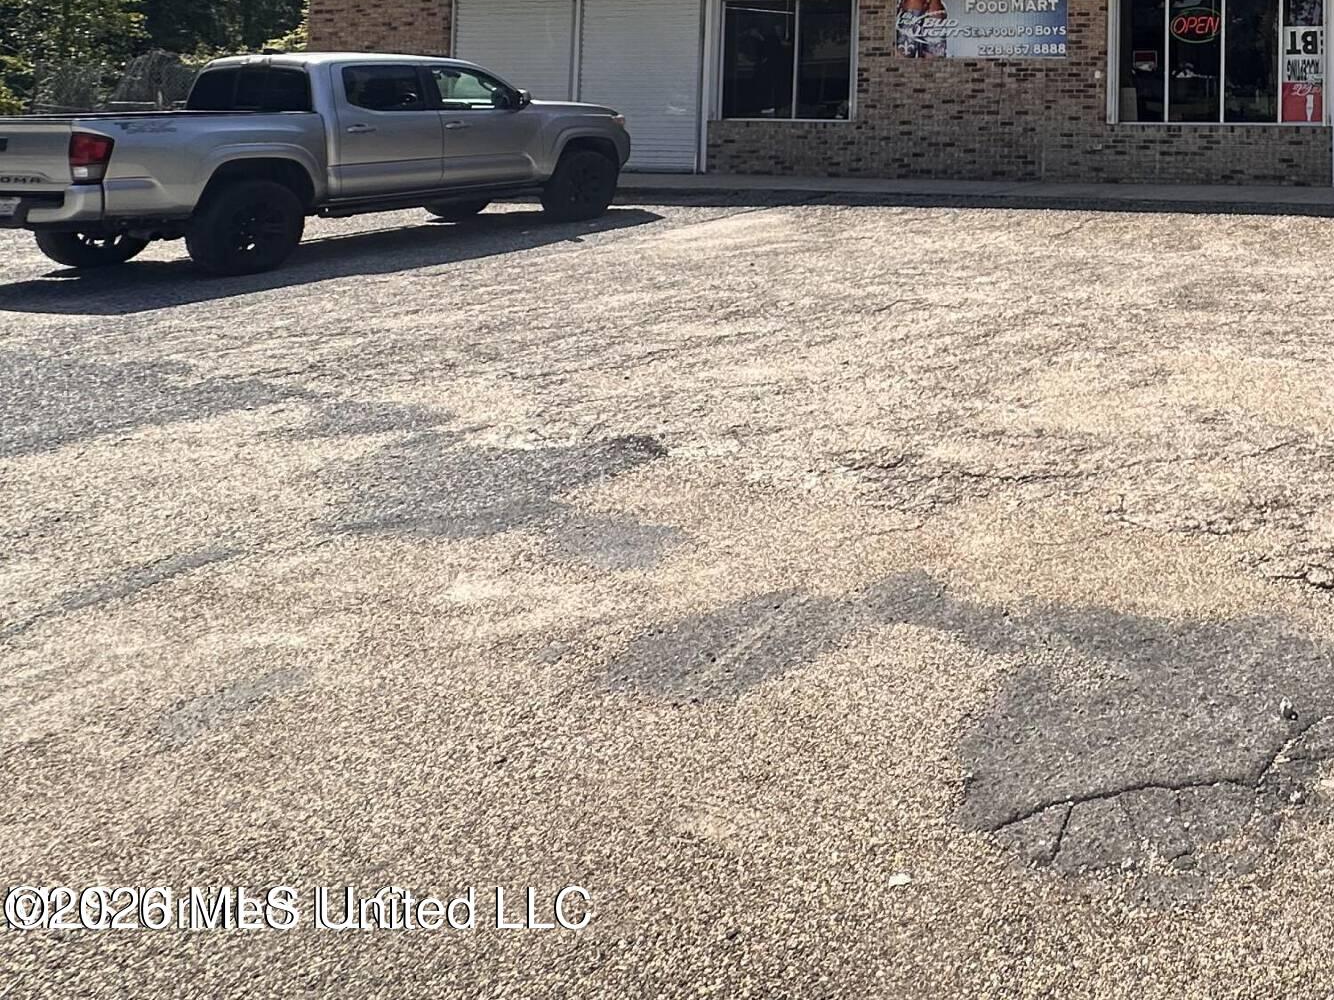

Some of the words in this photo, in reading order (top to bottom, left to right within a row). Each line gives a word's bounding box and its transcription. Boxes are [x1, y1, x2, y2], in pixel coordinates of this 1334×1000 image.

[965, 0, 1008, 13] FOOD
[923, 17, 959, 28] BUD
[1173, 16, 1220, 34] OPEN
